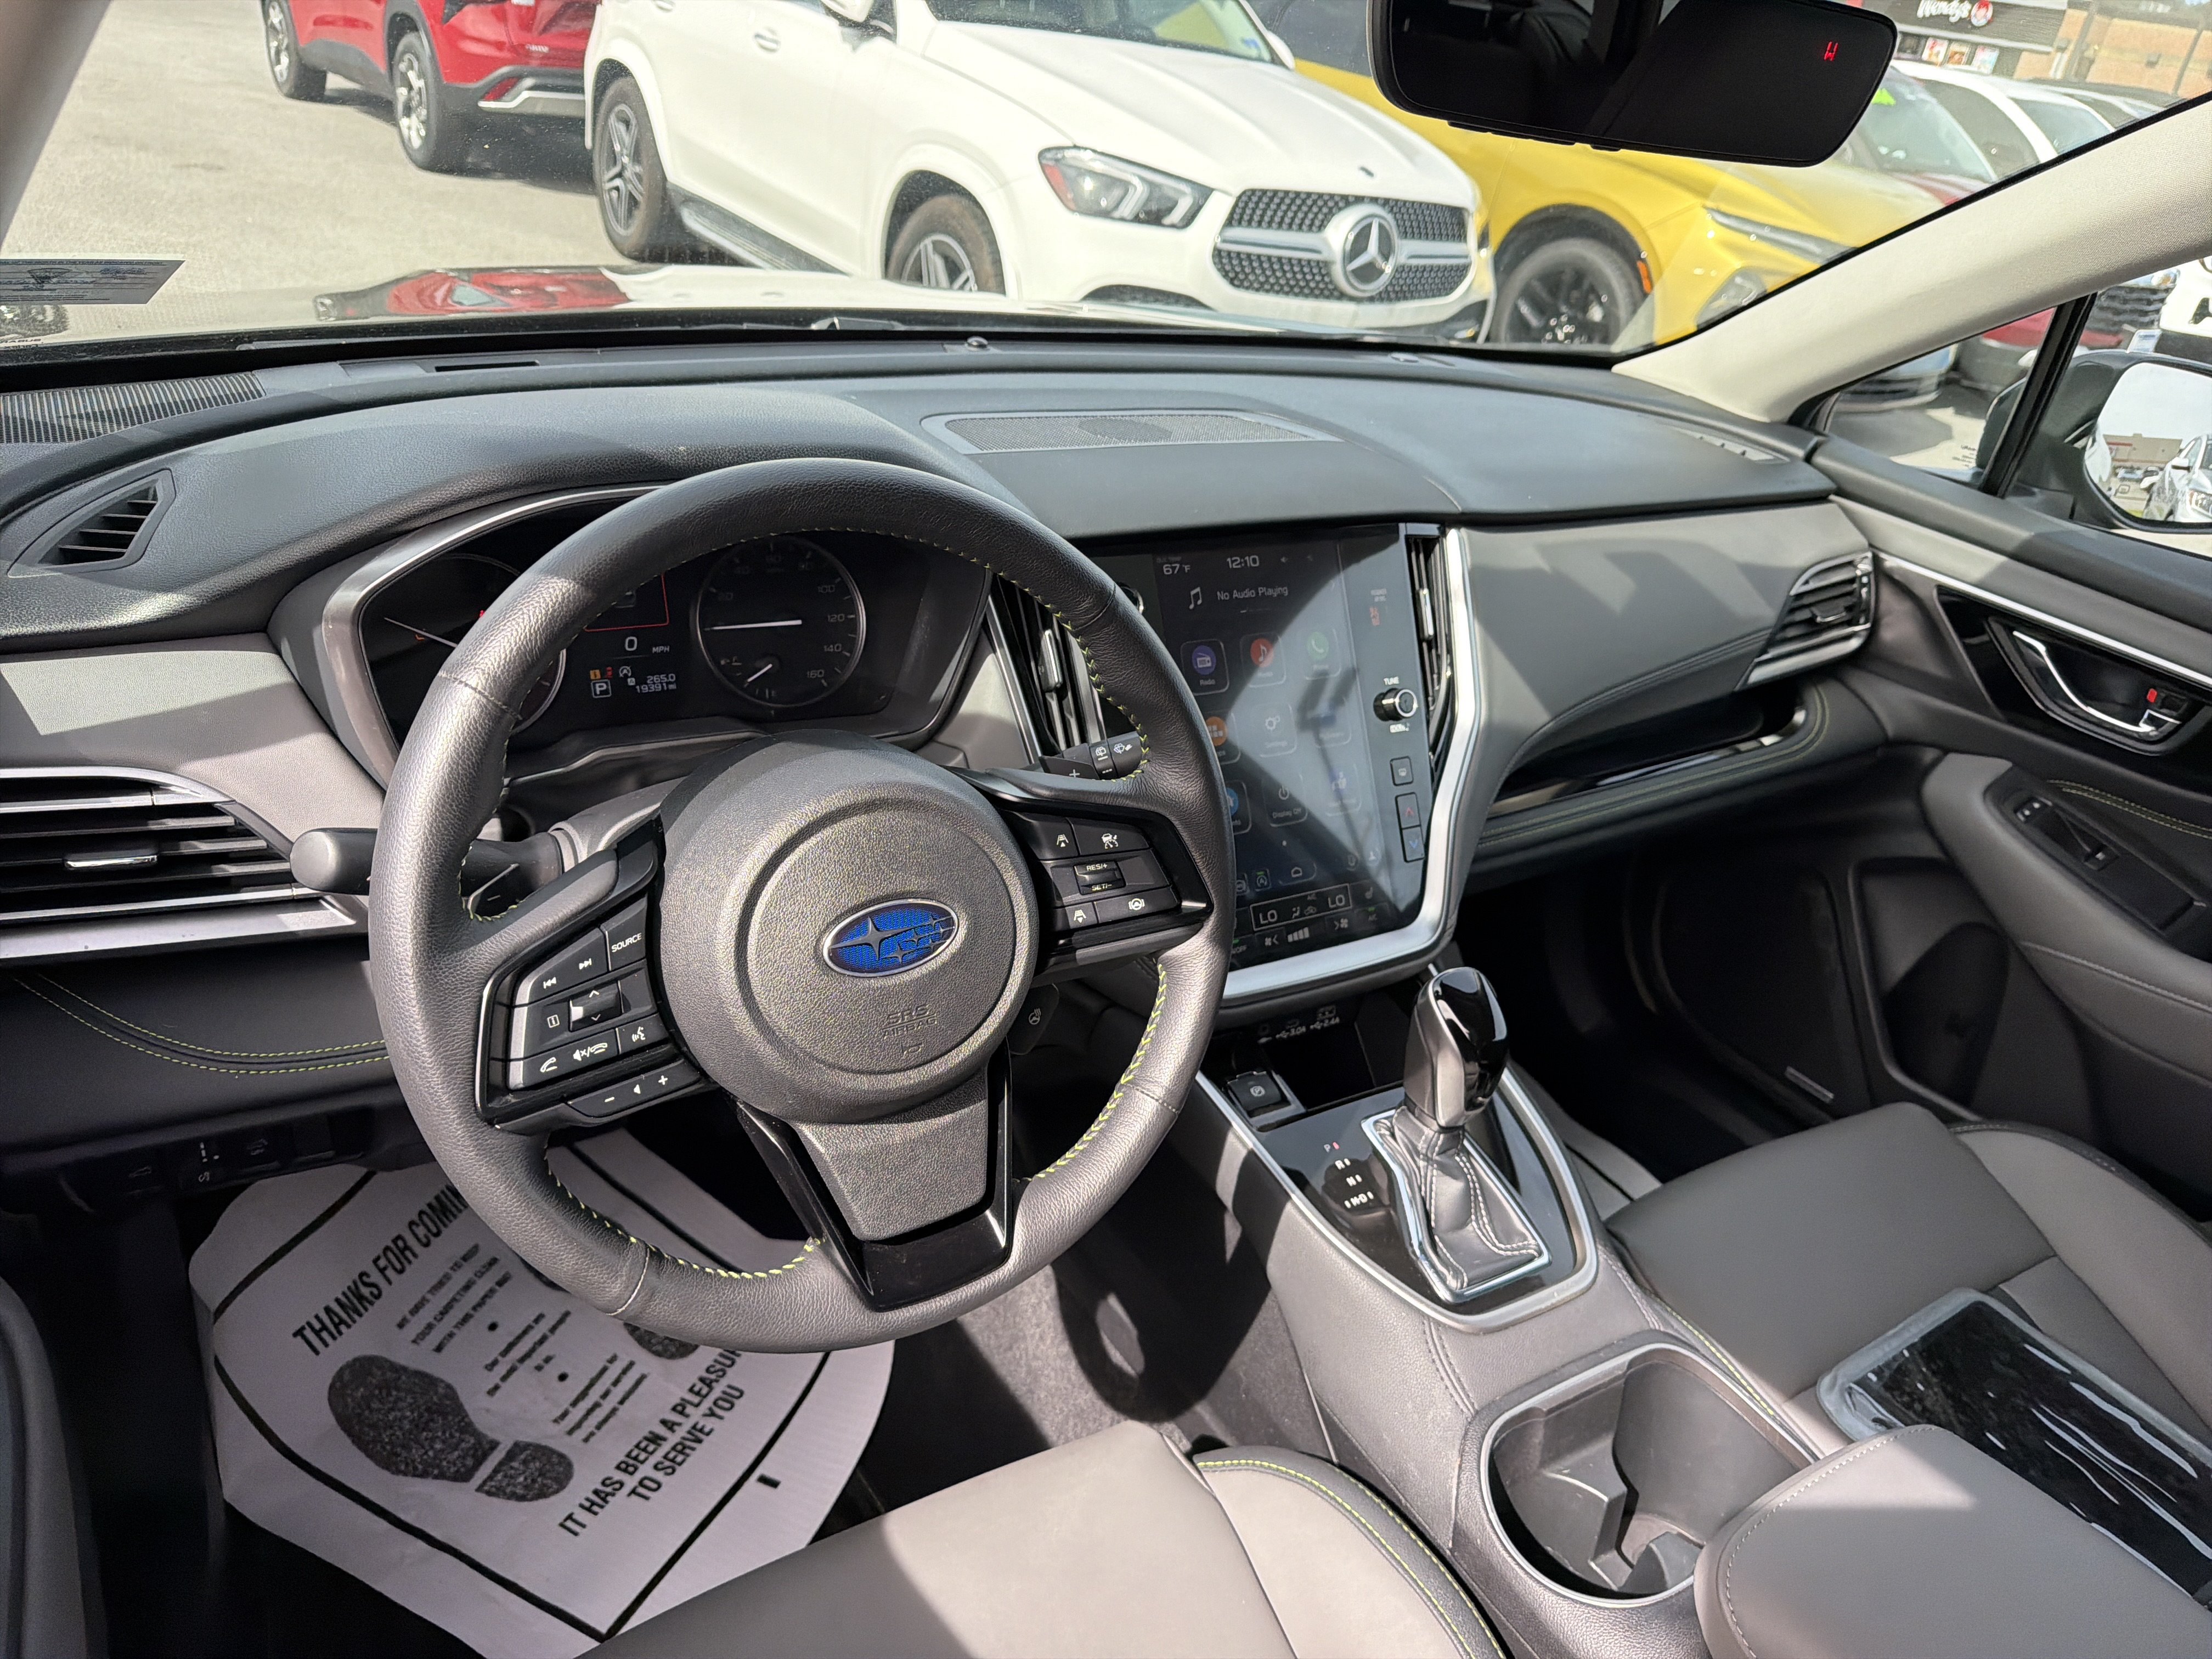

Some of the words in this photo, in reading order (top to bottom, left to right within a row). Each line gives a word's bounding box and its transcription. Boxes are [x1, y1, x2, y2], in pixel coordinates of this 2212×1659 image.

[1227, 555, 1260, 569] 12:10
[817, 585, 836, 594] 100
[1217, 590, 1230, 600] No
[1233, 589, 1256, 599] Audio
[1259, 585, 1288, 597] Playing
[827, 614, 845, 622] 120
[625, 636, 637, 652] 0
[652, 645, 670, 654] MPH
[823, 644, 842, 652] 140
[646, 673, 676, 684] 265.0
[806, 670, 825, 679] 160
[1384, 676, 1400, 685] TUNE
[1086, 863, 1108, 871] RES/+
[1328, 894, 1346, 908] LO
[1259, 910, 1277, 924] LO
[611, 932, 642, 953] SOURCE
[886, 1003, 930, 1024] SRS
[882, 1015, 938, 1040] AIRBAG
[1323, 1144, 1331, 1153] P
[1335, 1160, 1345, 1170] R
[292, 1271, 383, 1356] THANKS
[372, 1233, 419, 1286] FOR
[408, 1184, 469, 1248] COMIN
[557, 1511, 588, 1537] IT
[579, 1471, 624, 1517] HAS
[615, 1424, 669, 1476] BEEN
[658, 1409, 680, 1434] A
[671, 1347, 743, 1417] PLEASU
[627, 1475, 664, 1503] TO
[653, 1421, 714, 1476] SERVE
[703, 1383, 746, 1423] YOU
